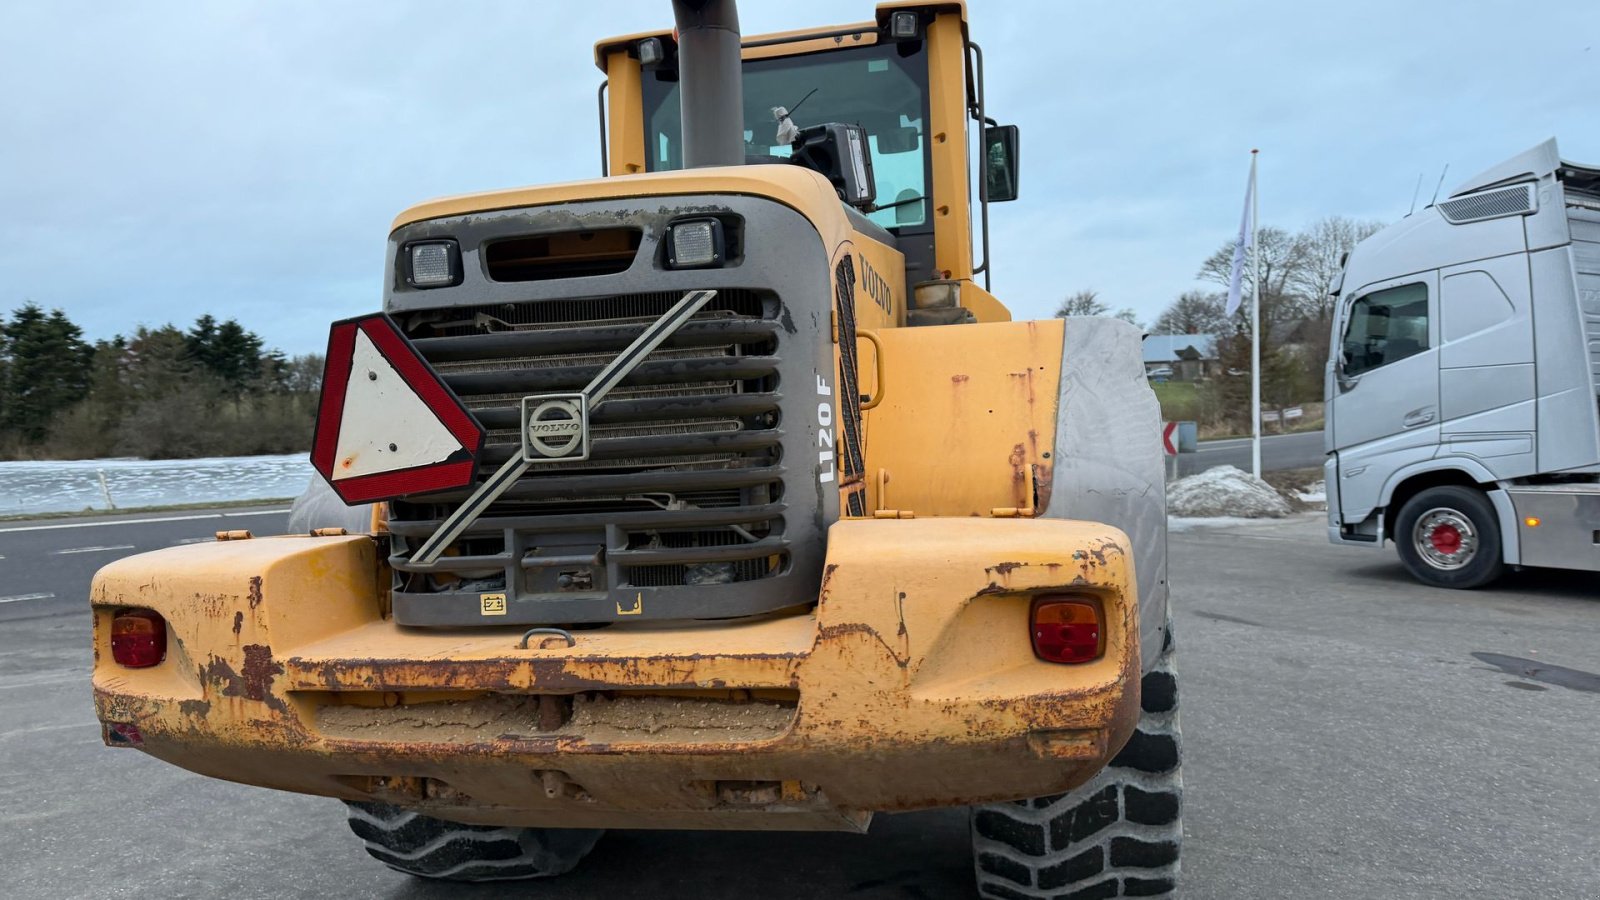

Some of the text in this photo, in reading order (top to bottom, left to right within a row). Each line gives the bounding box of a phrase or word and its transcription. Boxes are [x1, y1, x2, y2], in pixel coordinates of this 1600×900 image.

[859, 252, 892, 316] VOLVO
[530, 423, 580, 433] VOLVO
[816, 374, 834, 483] L120 F
